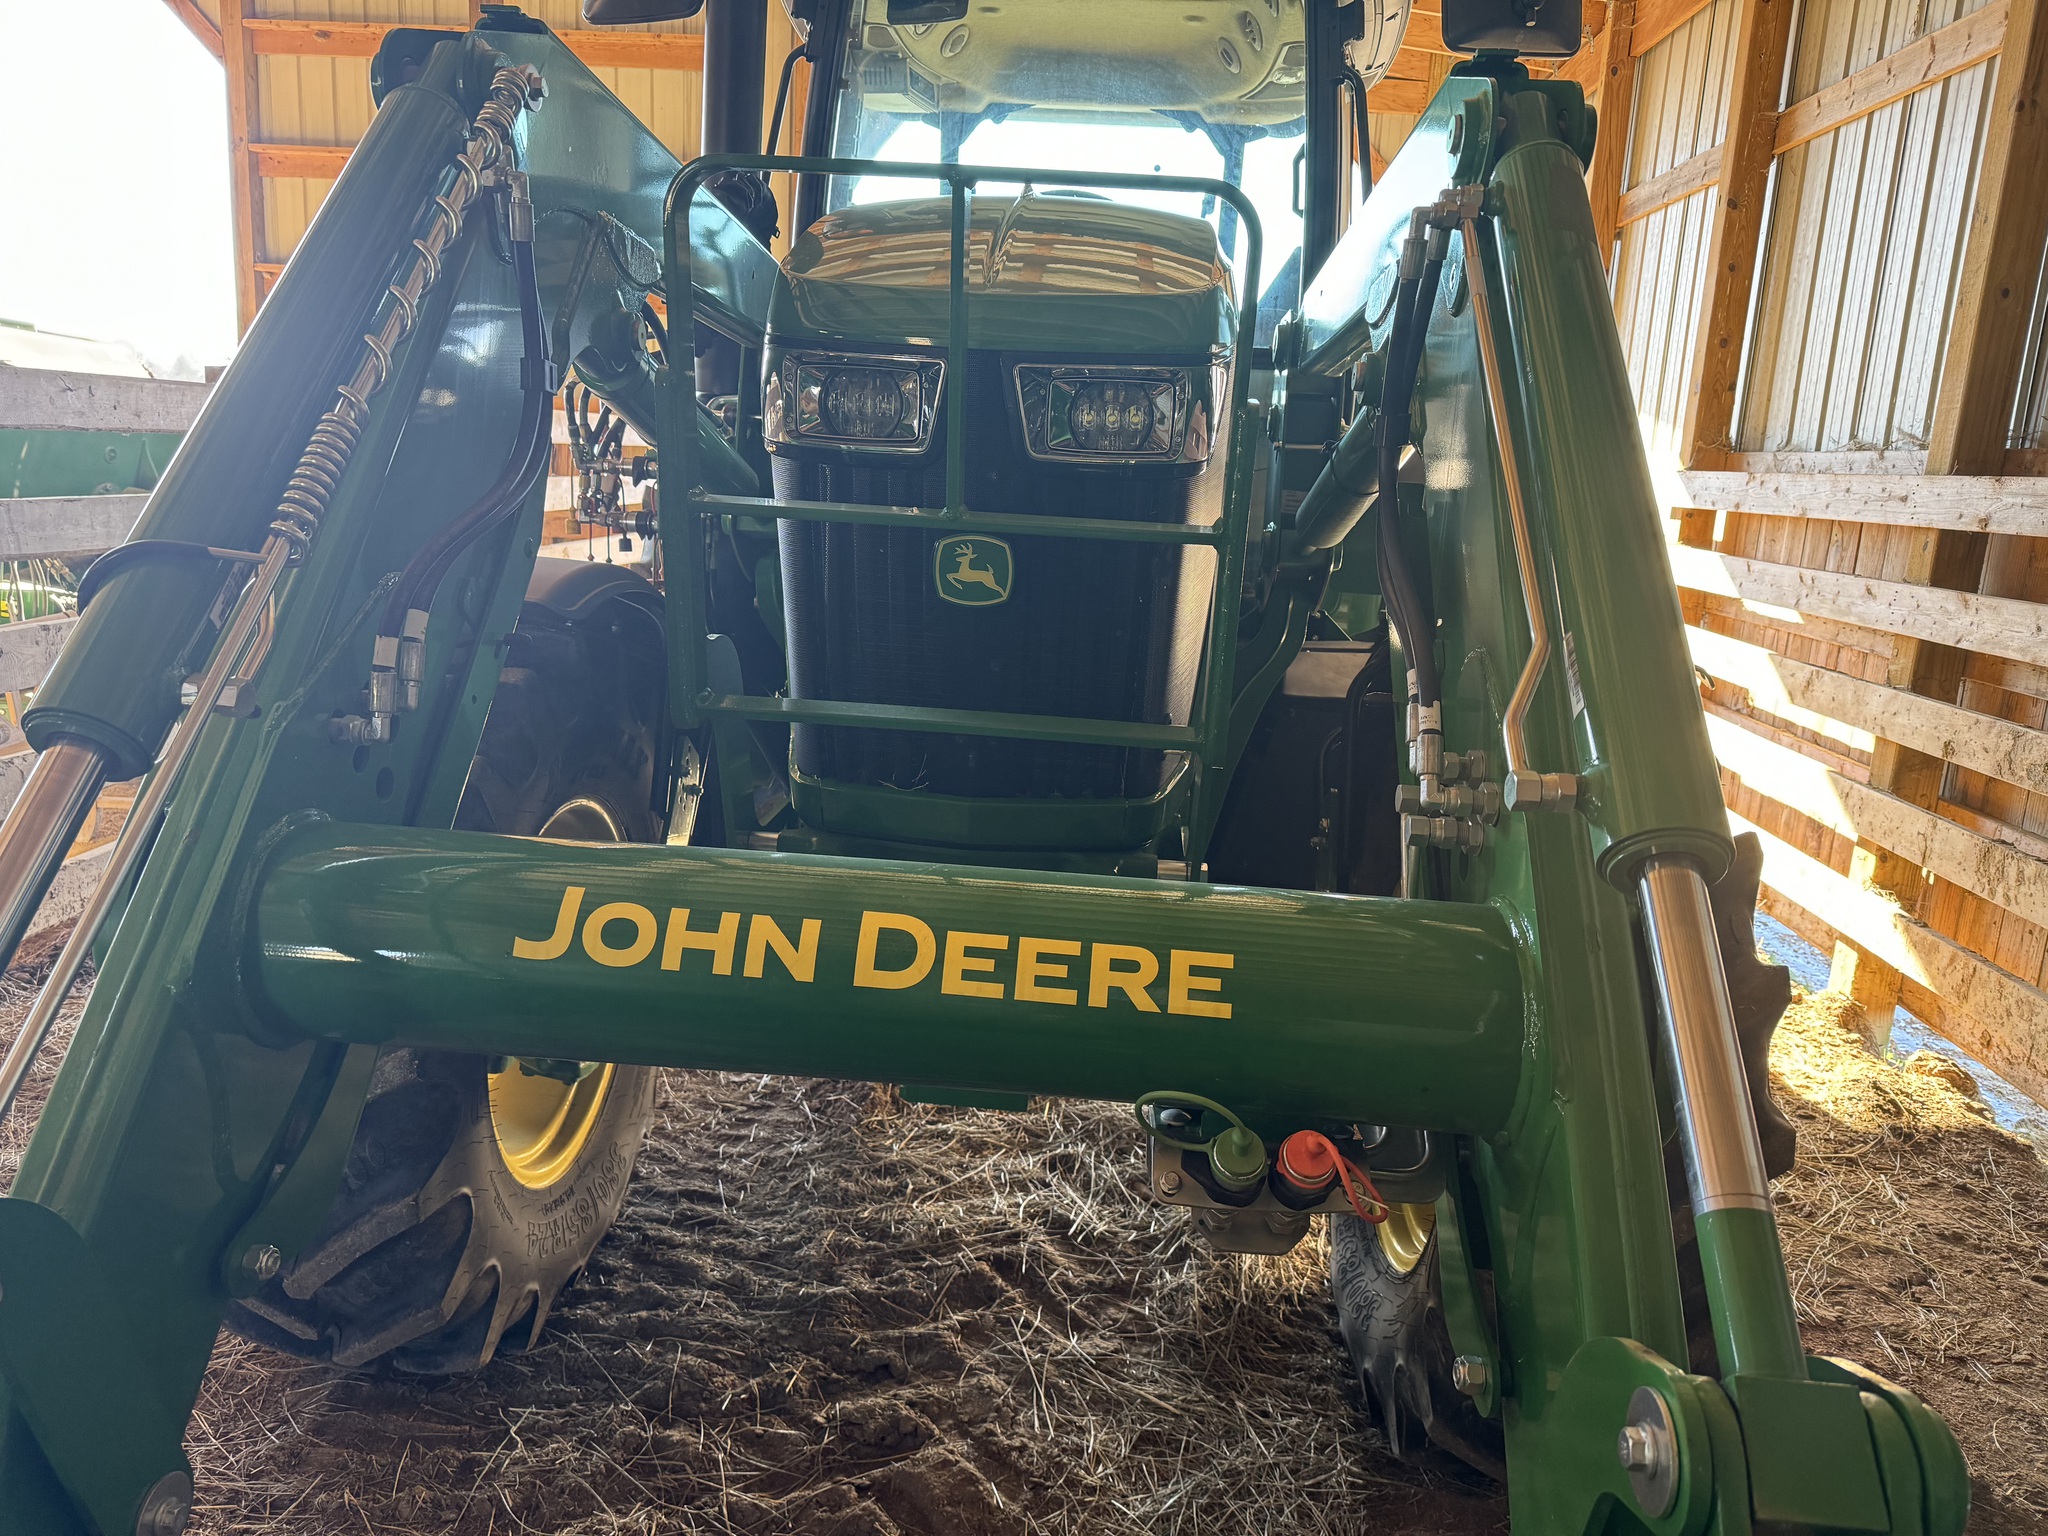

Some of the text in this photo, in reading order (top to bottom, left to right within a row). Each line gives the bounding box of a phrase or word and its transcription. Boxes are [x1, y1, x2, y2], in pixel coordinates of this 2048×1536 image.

[513, 886, 1234, 1019] JOHN DEERE
[527, 1142, 626, 1258] 380/85R24
[1336, 1214, 1381, 1331] 380/85R
